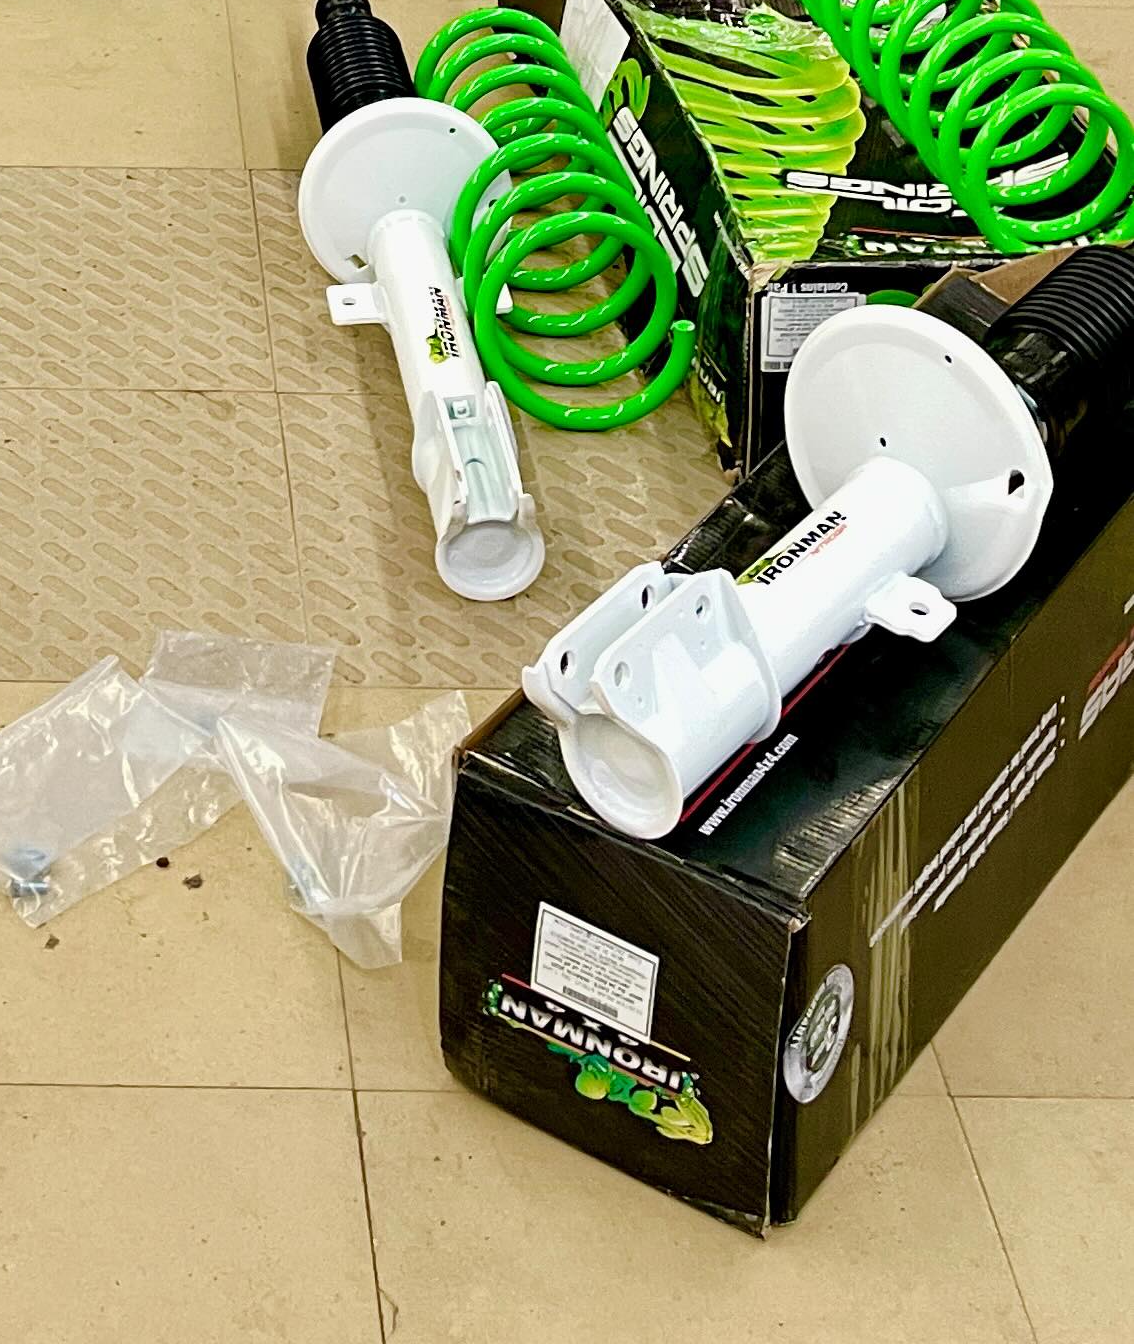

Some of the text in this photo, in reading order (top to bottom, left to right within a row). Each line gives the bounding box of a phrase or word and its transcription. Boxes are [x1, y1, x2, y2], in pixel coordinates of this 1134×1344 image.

[612, 106, 710, 298] SPRINGS
[801, 282, 848, 293] Contains
[756, 510, 847, 585] IRONMAN
[698, 732, 799, 837] www.ironman4x4.com
[497, 992, 682, 1092] IRONMAN
